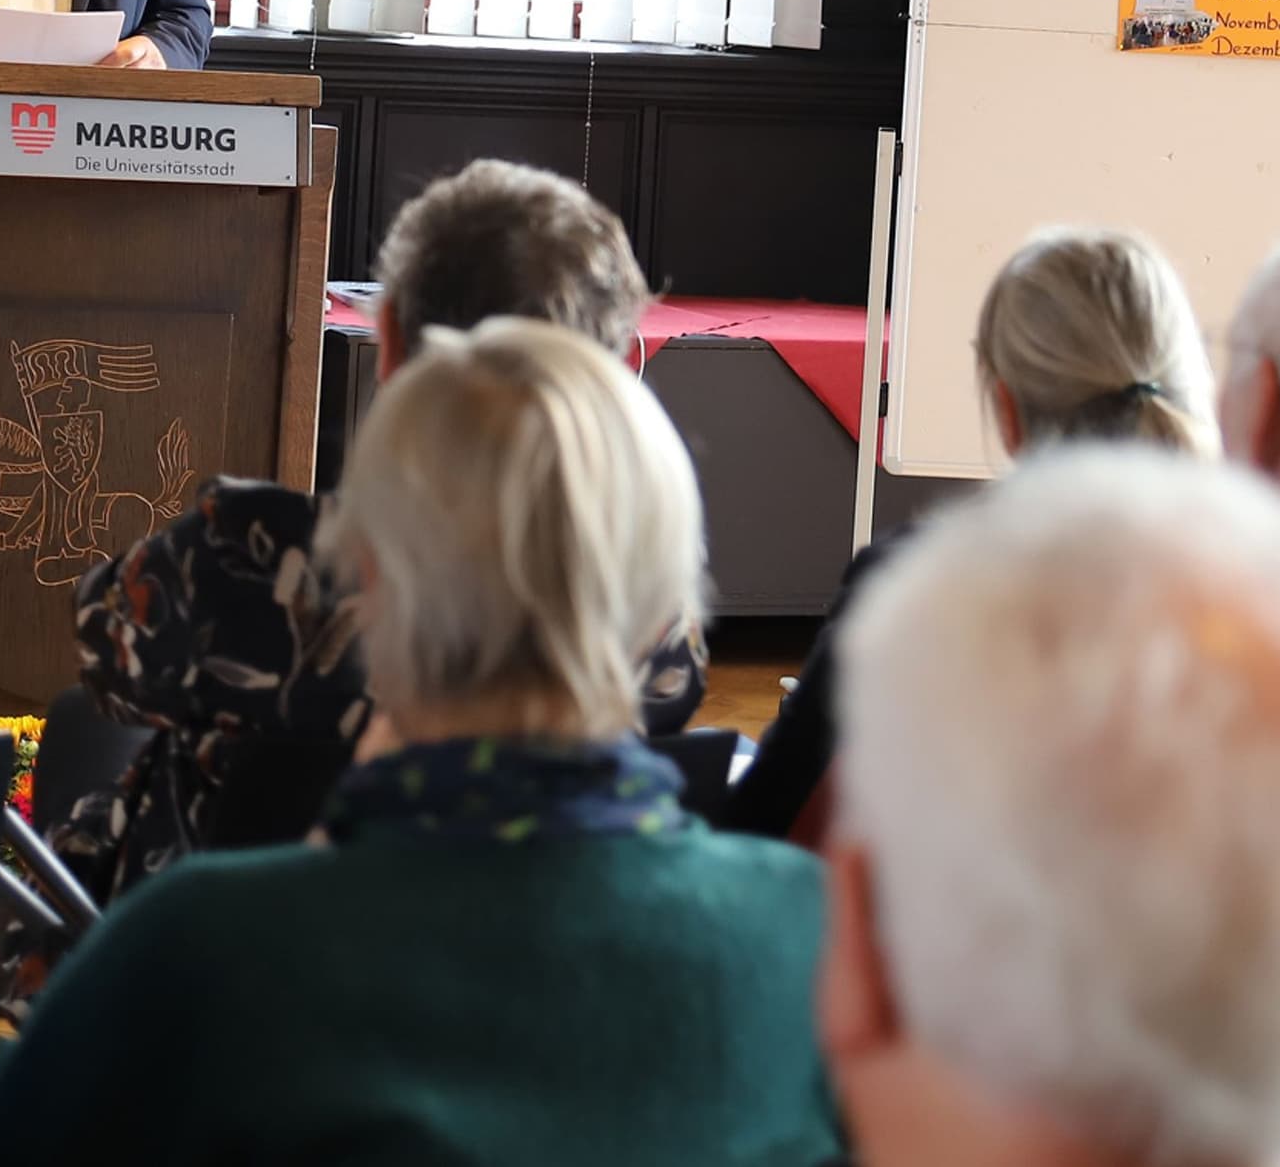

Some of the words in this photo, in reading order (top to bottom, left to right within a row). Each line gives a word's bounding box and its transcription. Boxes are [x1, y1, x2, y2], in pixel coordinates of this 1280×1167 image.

[75, 121, 236, 152] MARBURG
[75, 156, 101, 172] Die
[105, 156, 235, 177] Universitätsstadt
